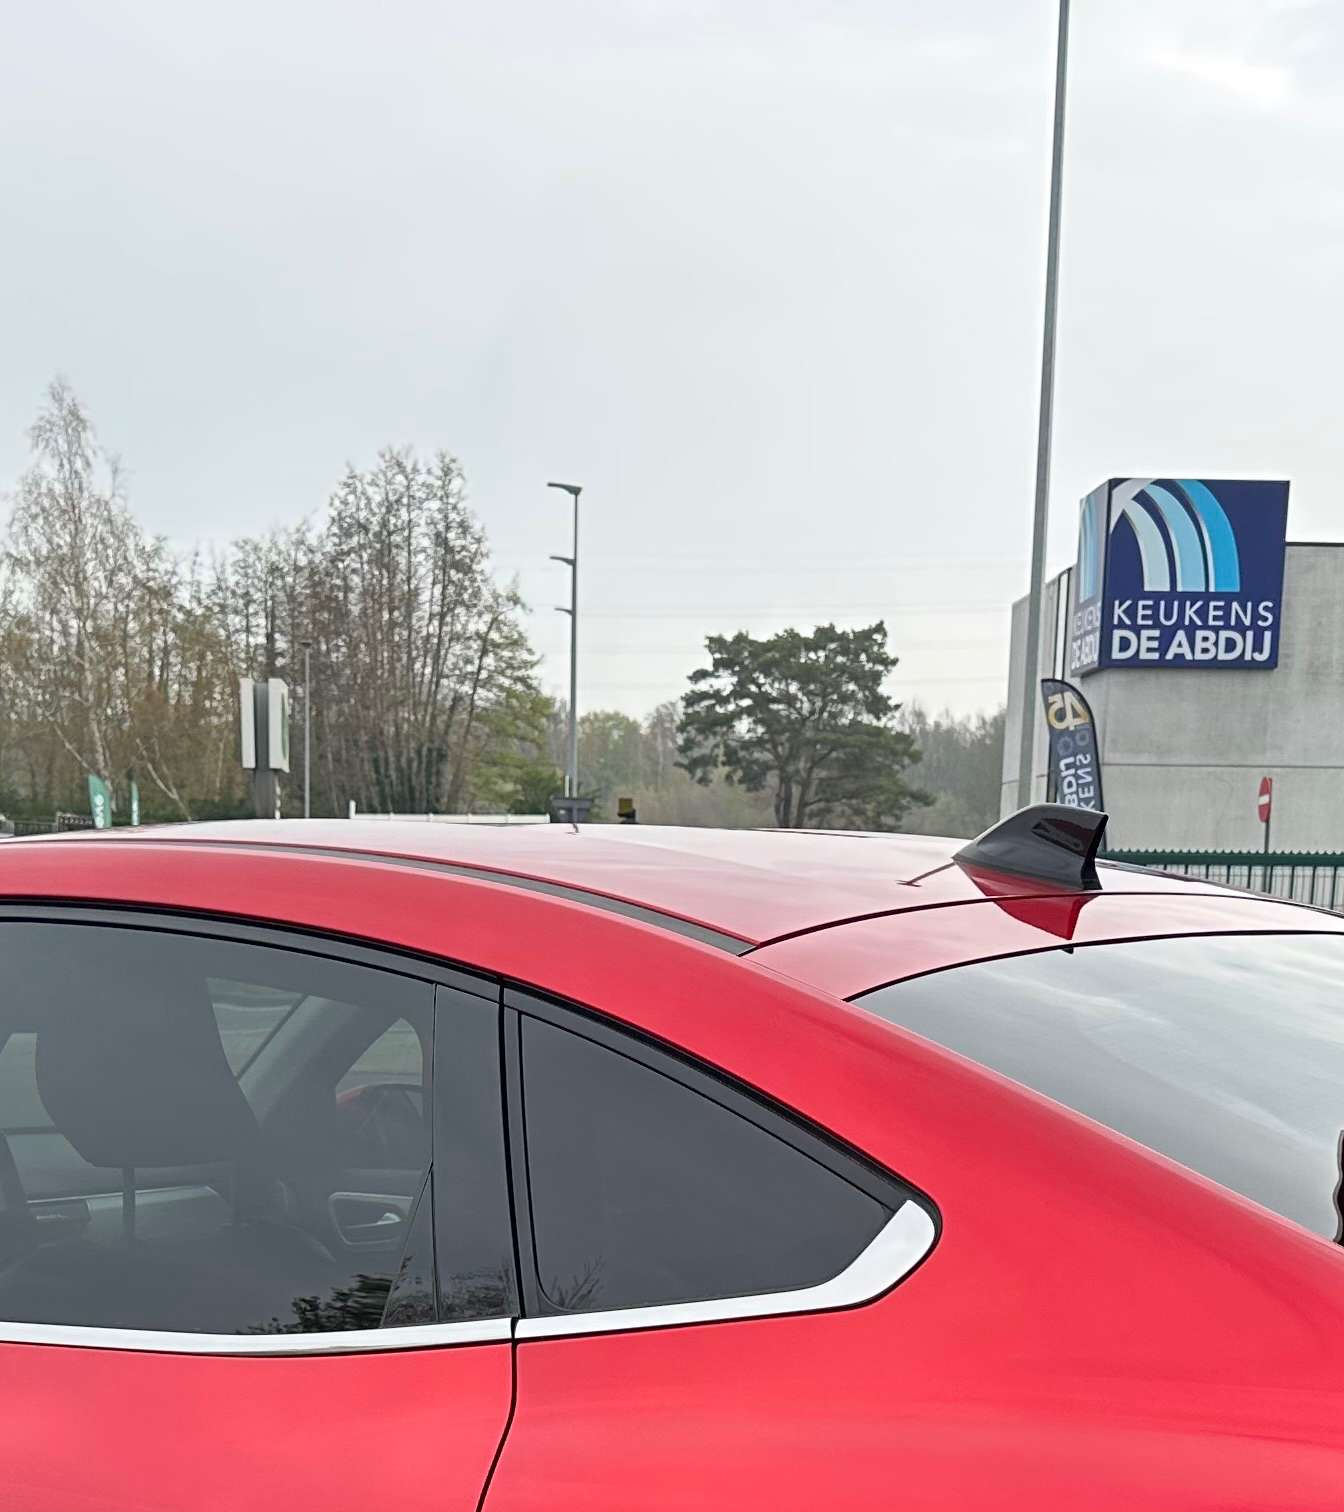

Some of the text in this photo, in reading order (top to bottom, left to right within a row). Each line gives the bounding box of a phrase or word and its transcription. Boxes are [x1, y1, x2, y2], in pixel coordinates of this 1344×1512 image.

[1113, 600, 1274, 627] KEUKENS
[1111, 629, 1160, 660] DE
[1165, 629, 1272, 662] ABDIJ
